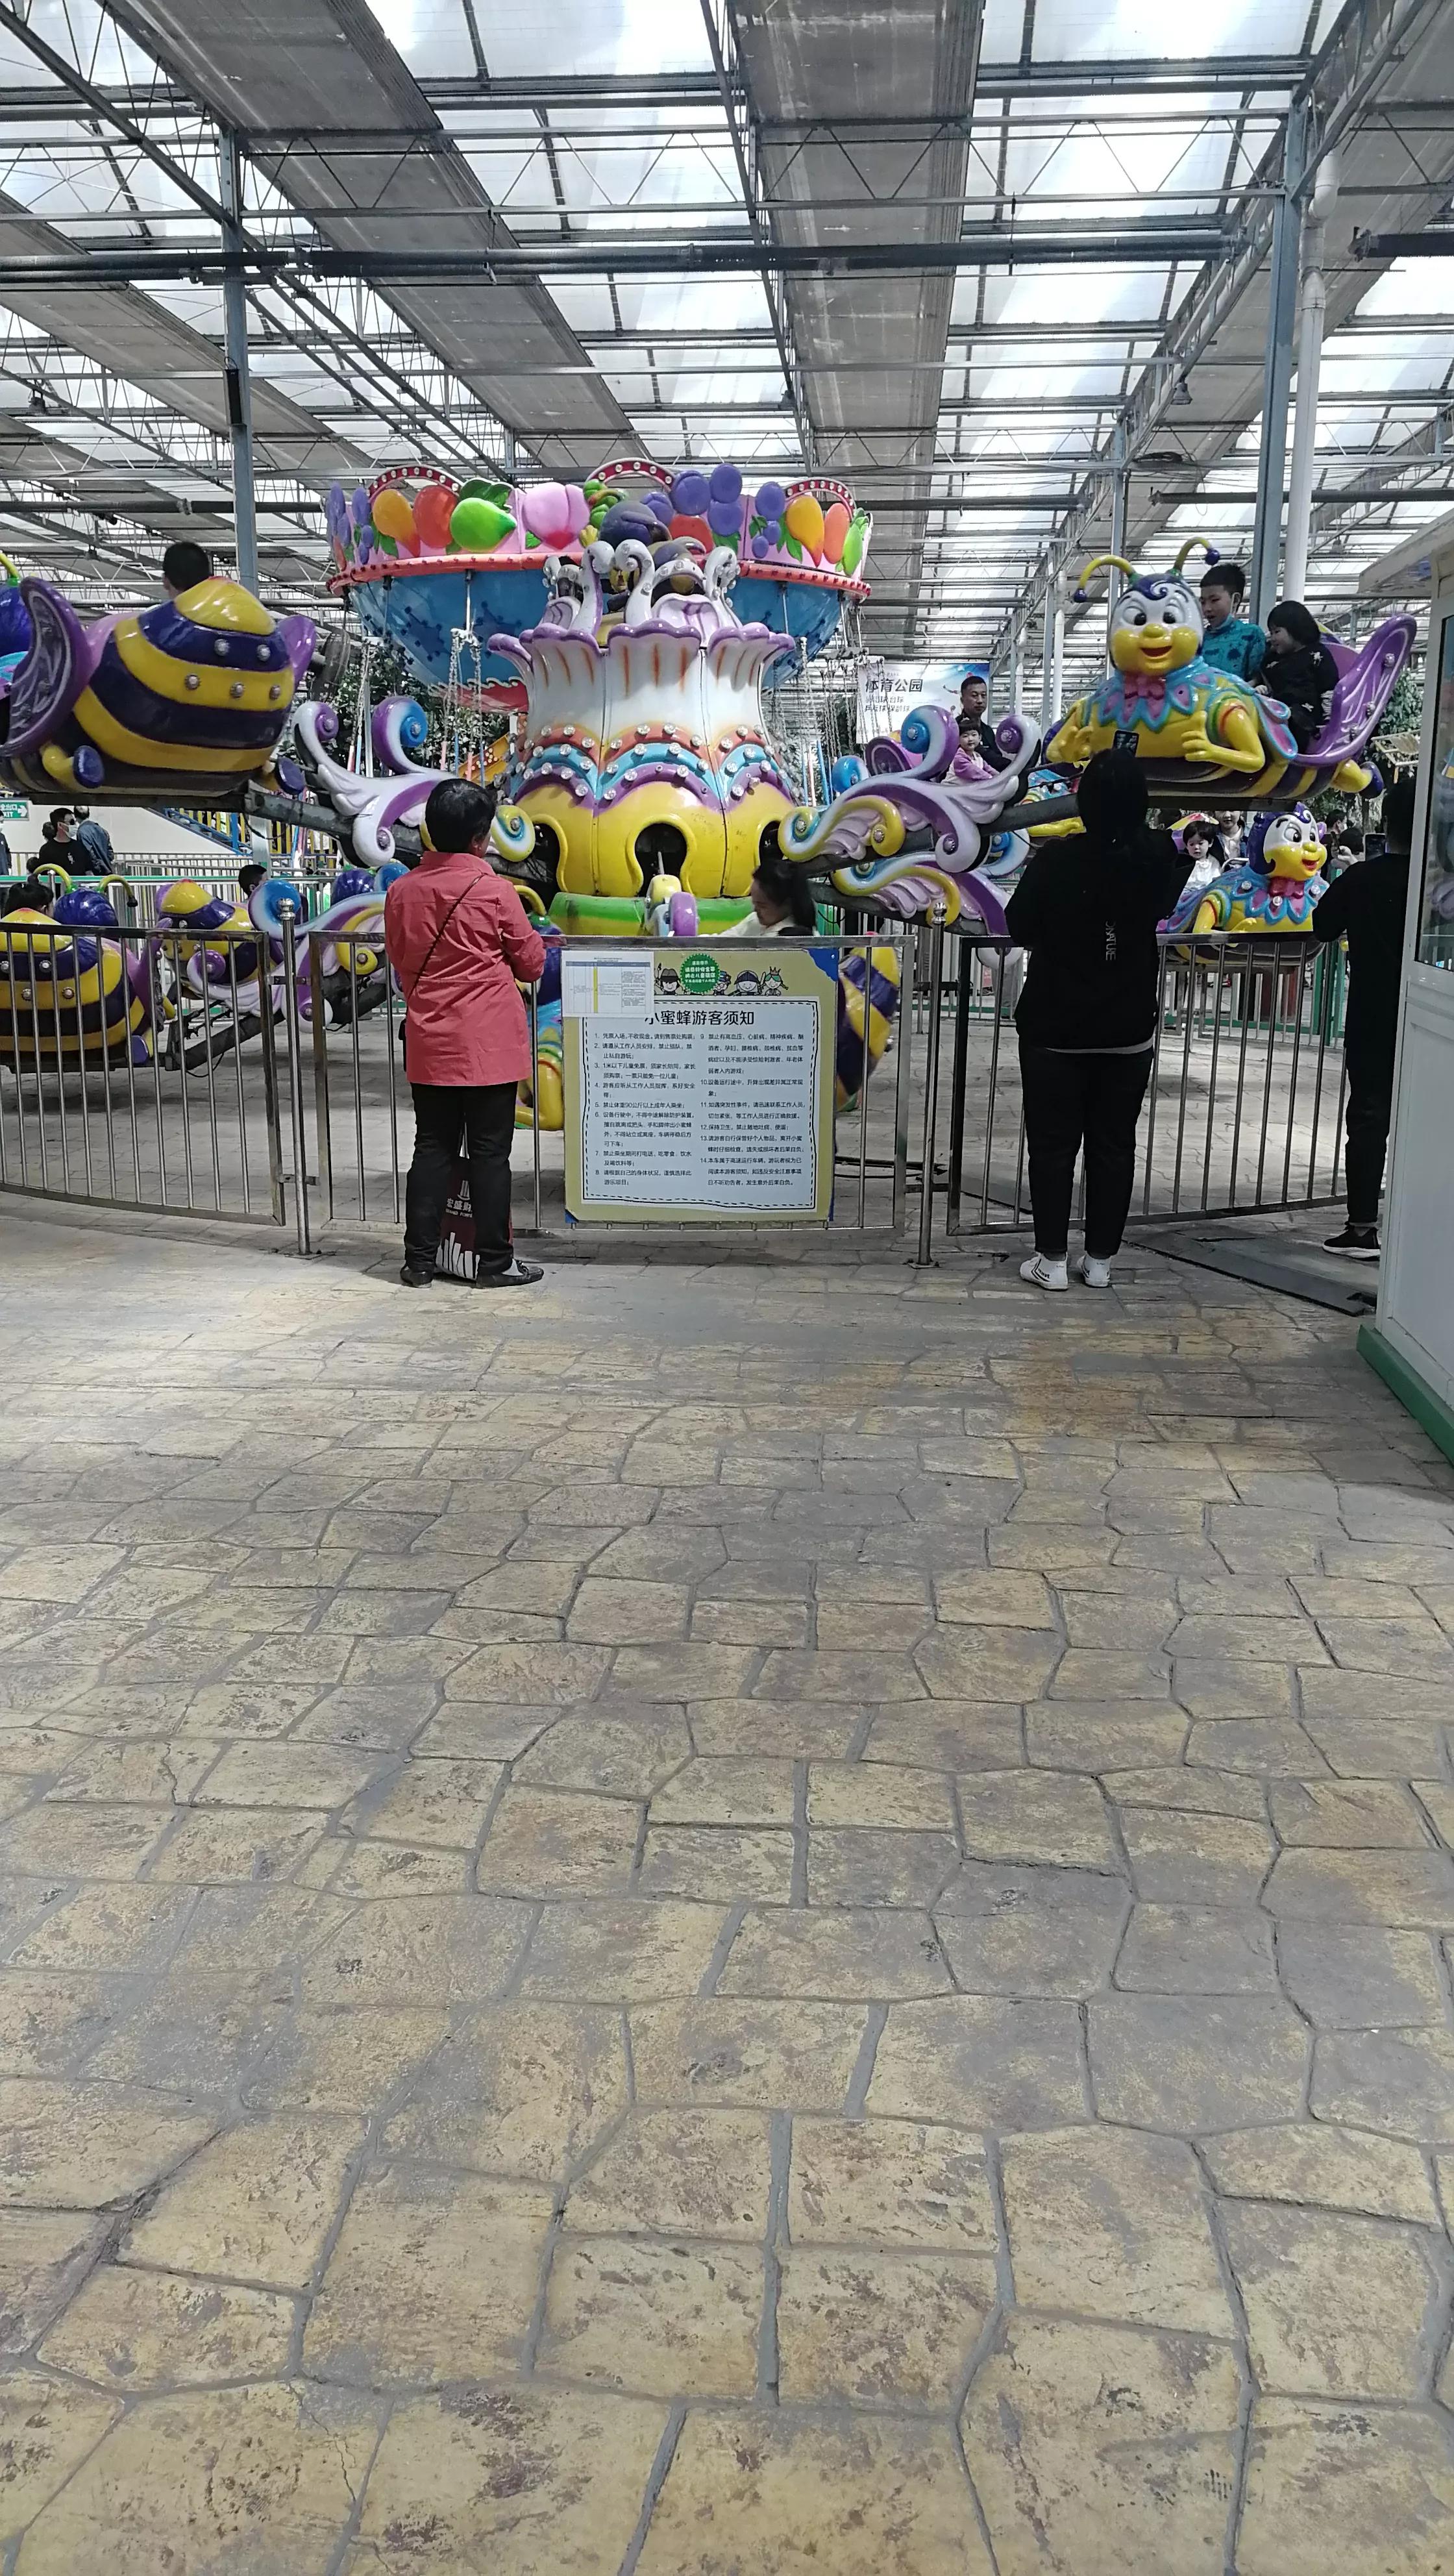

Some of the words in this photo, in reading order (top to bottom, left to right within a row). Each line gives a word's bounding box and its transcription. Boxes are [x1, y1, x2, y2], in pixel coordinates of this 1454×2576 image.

[865, 678, 923, 693] 体育公园
[645, 1010, 754, 1025] 小蜜蜂游客须知
